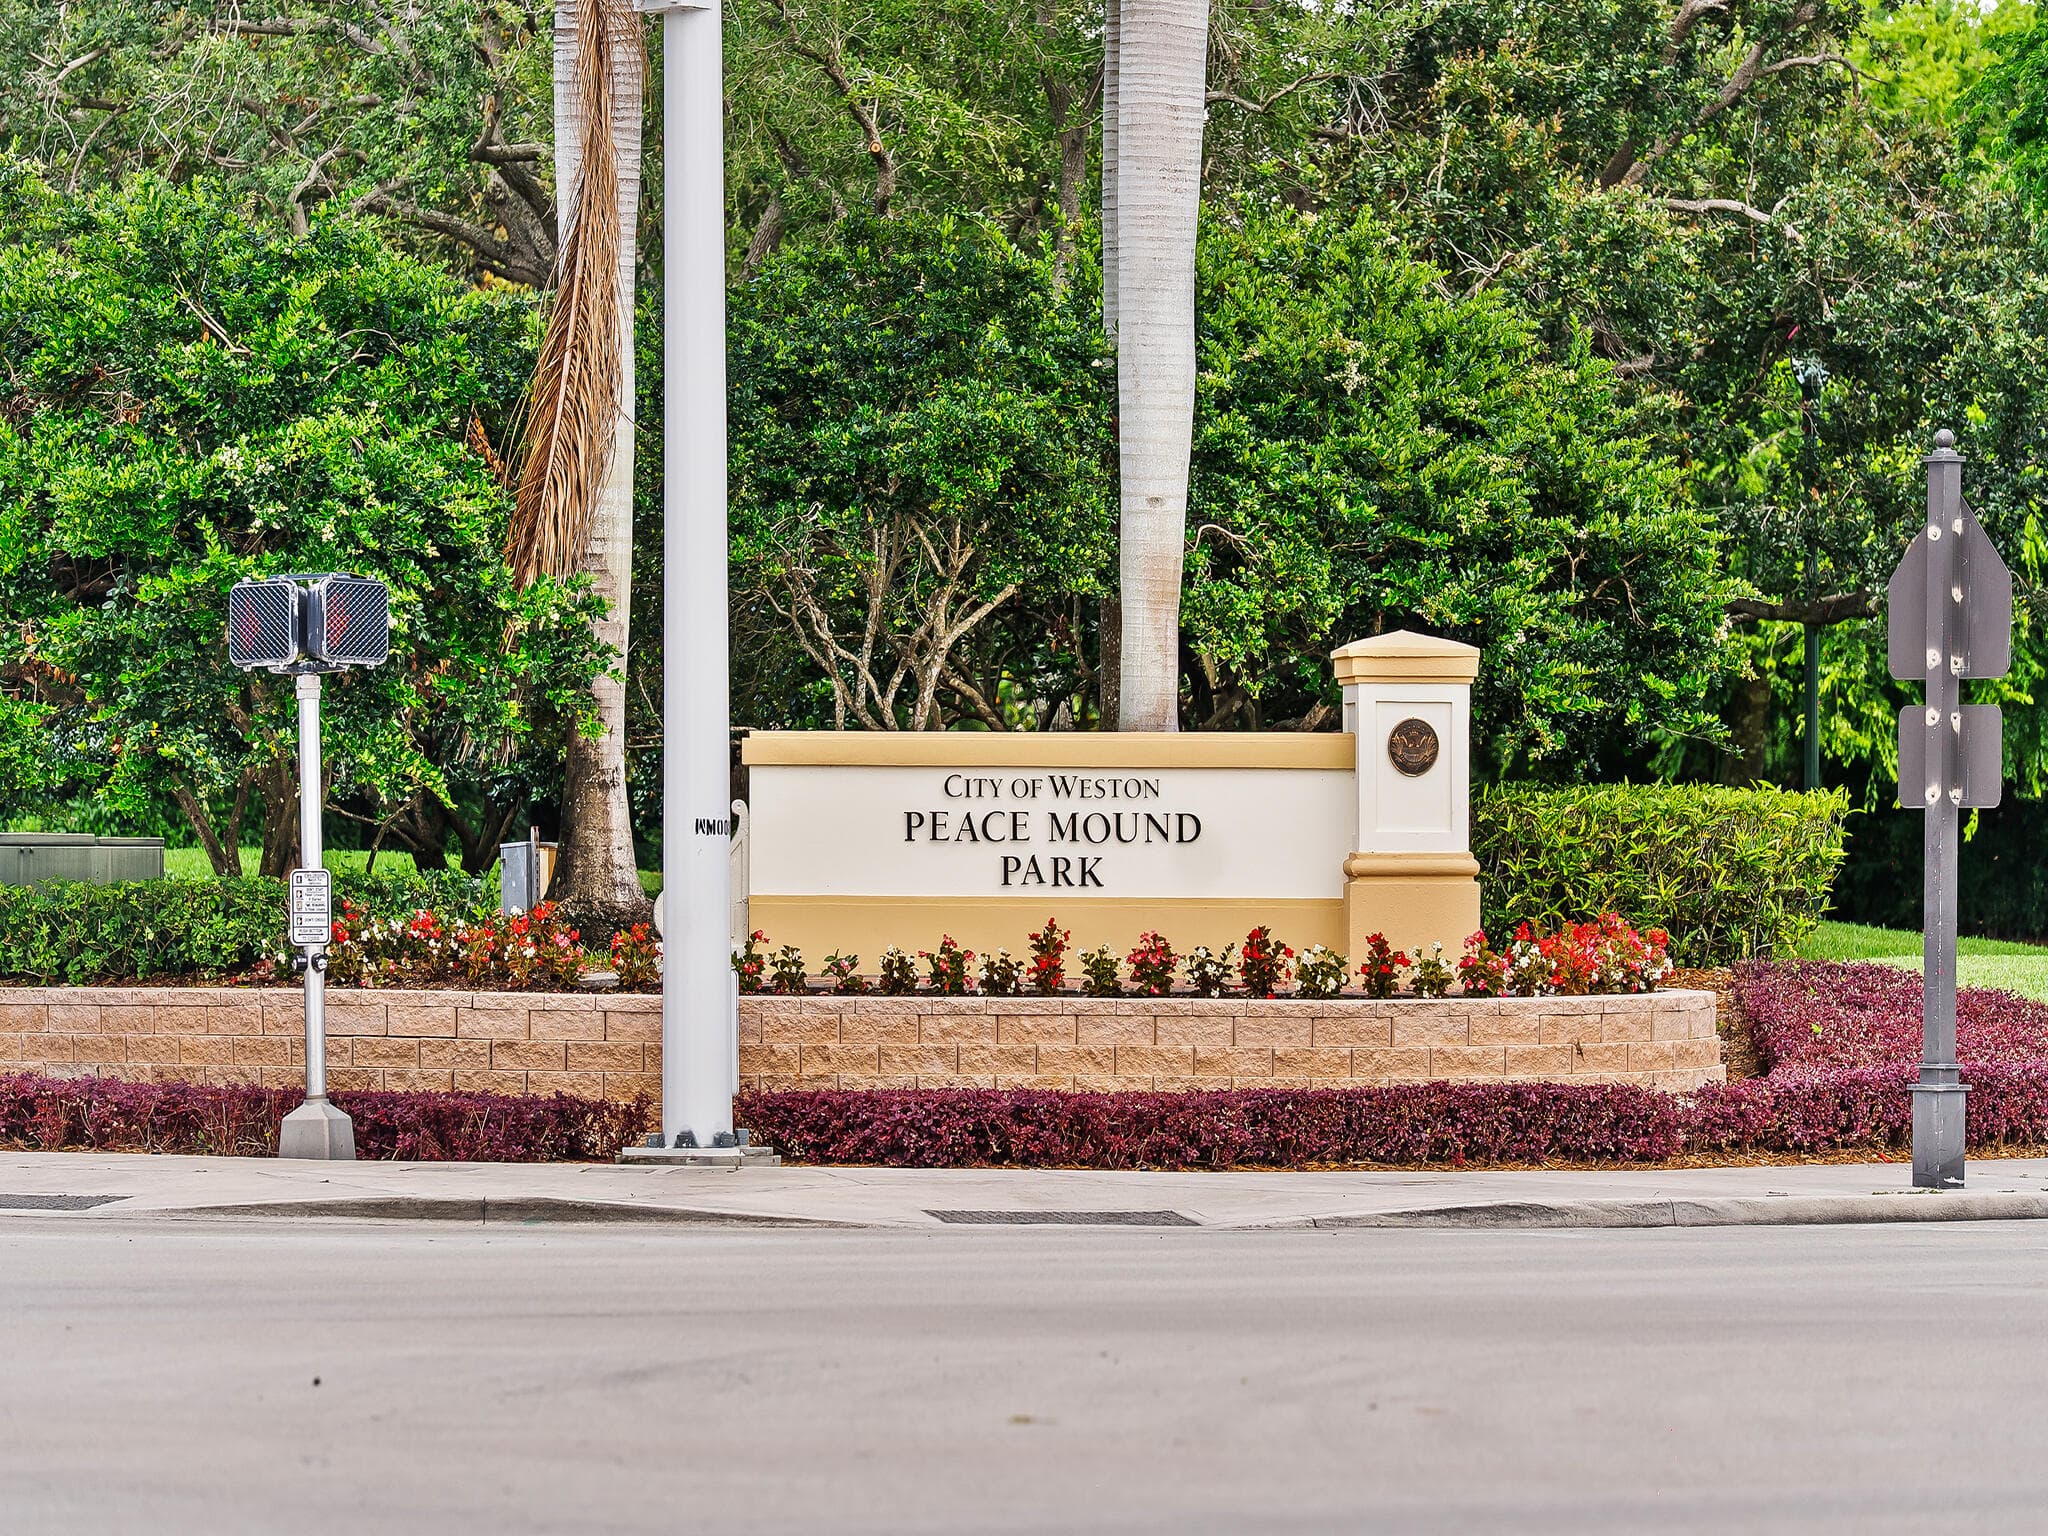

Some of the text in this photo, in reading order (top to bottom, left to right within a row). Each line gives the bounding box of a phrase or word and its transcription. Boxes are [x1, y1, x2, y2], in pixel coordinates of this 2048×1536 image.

[944, 774, 1160, 800] CITY OF WESTON
[904, 811, 1202, 844] PEACE MOUND
[1001, 855, 1105, 888] PARK
